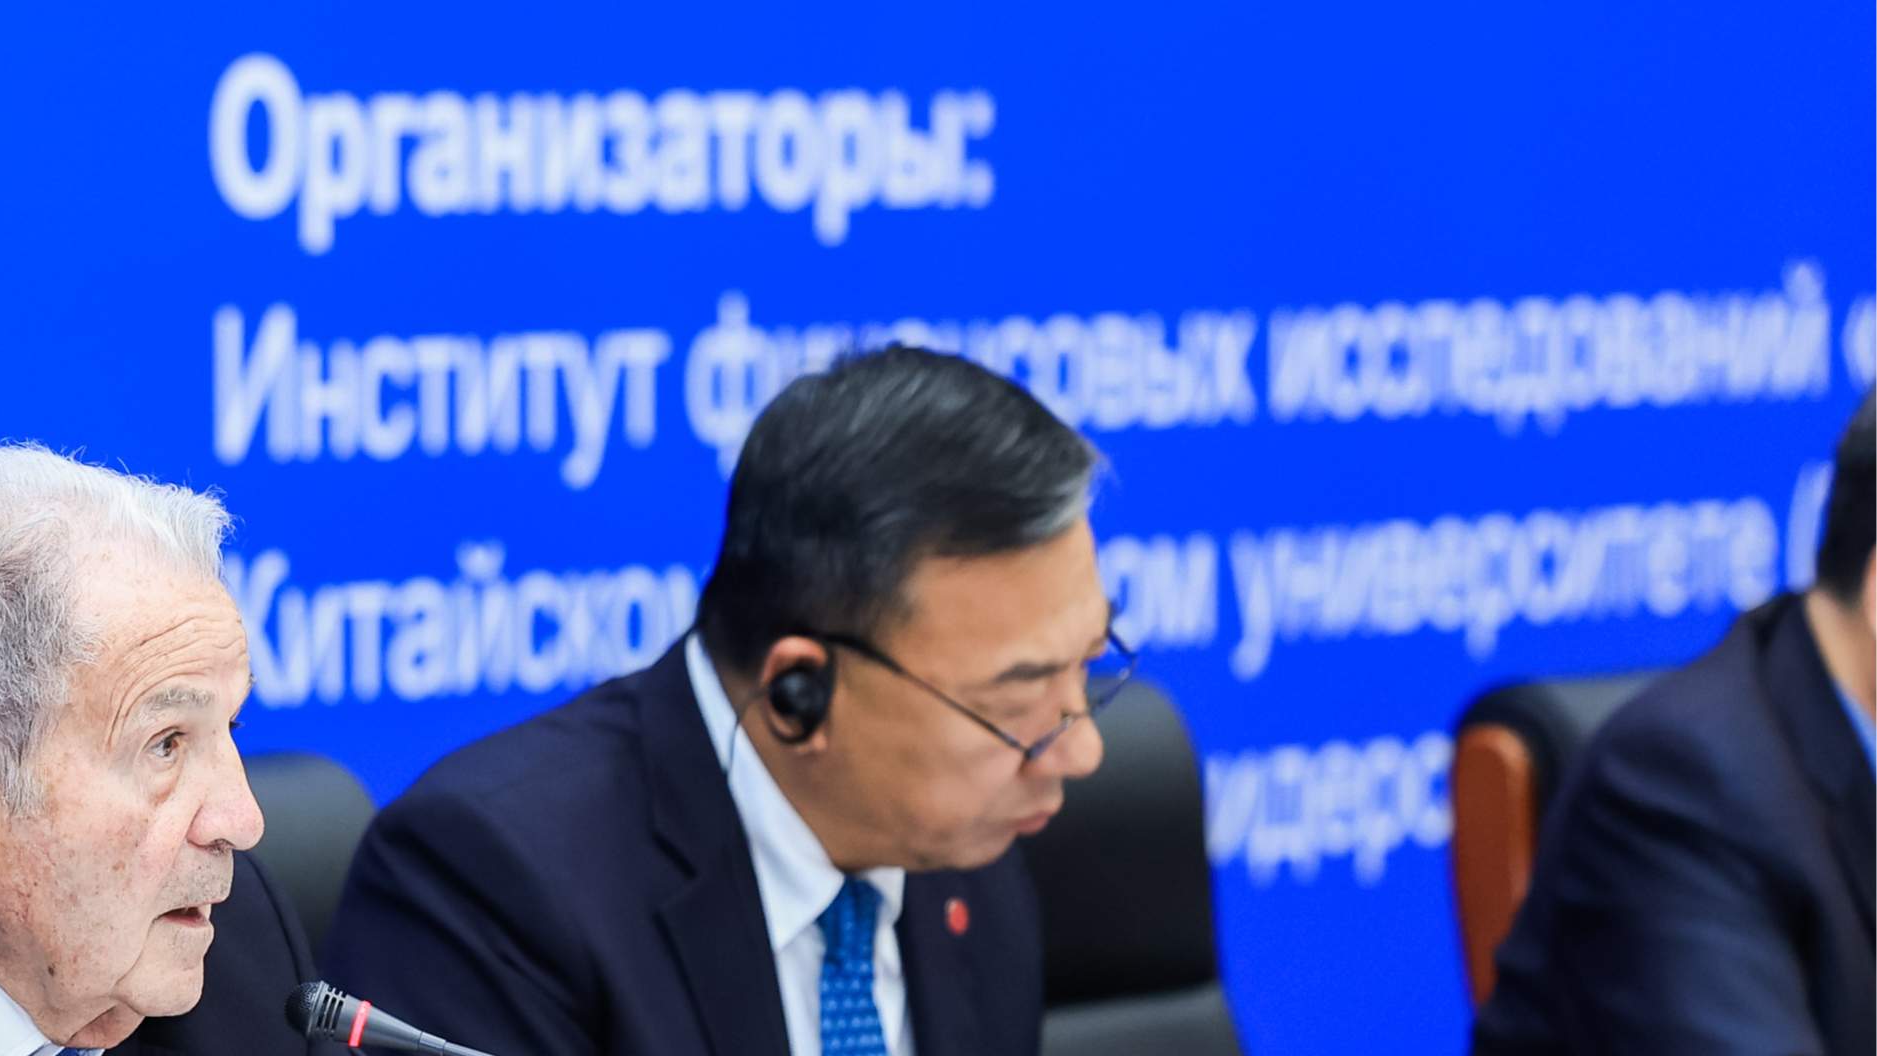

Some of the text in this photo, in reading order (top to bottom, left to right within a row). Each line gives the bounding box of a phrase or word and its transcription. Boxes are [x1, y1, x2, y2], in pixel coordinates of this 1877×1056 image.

[209, 54, 994, 254] Организаторы:
[211, 303, 672, 488] Институт
[1268, 262, 1831, 432] исследований
[1228, 497, 1779, 680] университете
